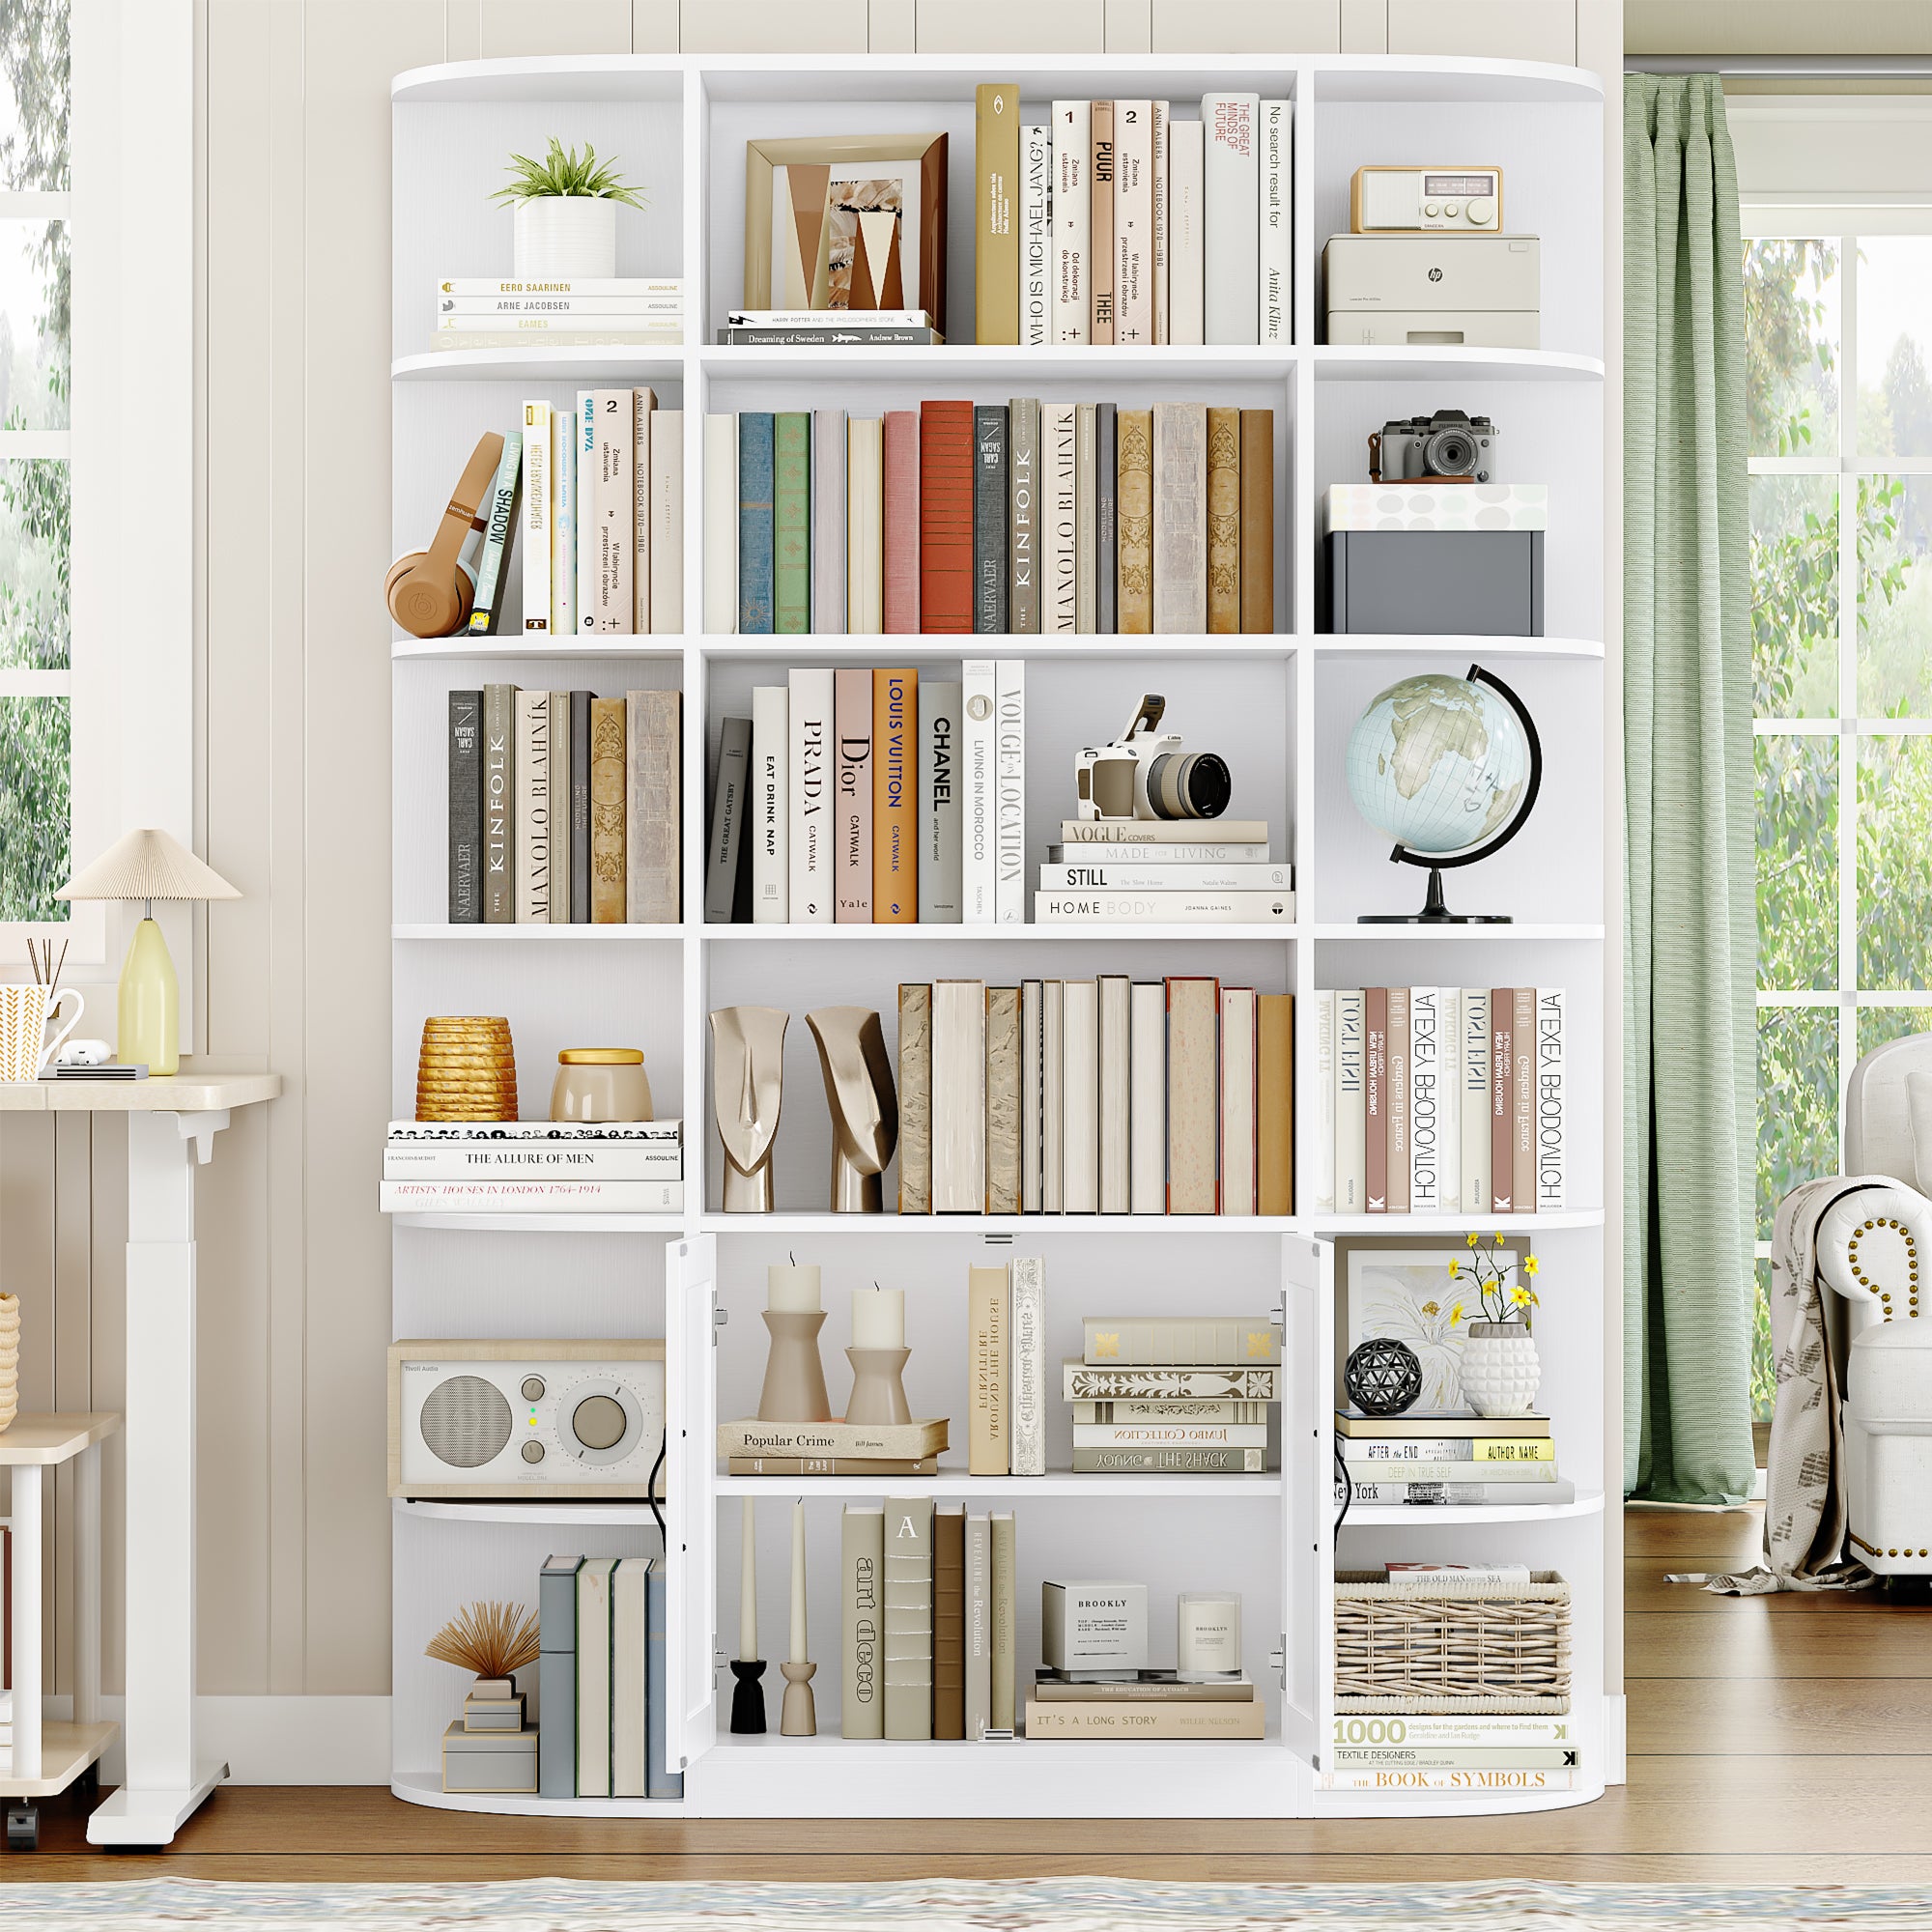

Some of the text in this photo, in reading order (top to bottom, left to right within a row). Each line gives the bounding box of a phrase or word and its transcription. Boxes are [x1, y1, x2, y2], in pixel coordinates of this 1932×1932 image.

[1065, 111, 1073, 123] 1
[1125, 111, 1137, 123] 2
[1215, 102, 1226, 142] FUTURE
[1227, 102, 1237, 150] MINDS OF
[1238, 103, 1250, 157] THE GREAT
[1096, 141, 1112, 182] PUUR
[1269, 106, 1281, 228] No search result for
[1029, 142, 1043, 345] WHO IS MICHAEL JANG?
[1061, 249, 1069, 303] do konstrukcji
[1070, 252, 1080, 300] Od dekoracji
[1428, 268, 1442, 282] hp
[500, 283, 523, 292] EERO
[526, 283, 571, 292] SAARINEN
[497, 301, 521, 310] ARNE
[524, 301, 570, 310] JACOBSEN
[1096, 291, 1112, 324] THEE
[1268, 268, 1281, 339] Anita Klinz
[519, 320, 549, 328] EAMES
[749, 333, 784, 344] Dreaming
[786, 333, 795, 342] of
[795, 333, 824, 342] Sweden
[607, 400, 617, 412] 2
[506, 441, 520, 469] LIVING
[980, 441, 1001, 453] SAGAN
[983, 454, 999, 464] CARL
[504, 470, 515, 480] IN
[490, 489, 513, 545] SHADOW
[1053, 412, 1074, 631] MANOLO BLAHNÍK
[984, 558, 997, 633] NAERVAER
[890, 679, 903, 729] LOUIS
[804, 720, 822, 816] PRADA
[933, 718, 951, 812] CHANEL
[974, 740, 983, 779] LIVING
[889, 736, 903, 808] VUITTON
[974, 781, 983, 794] IN
[489, 735, 504, 873] KINFOLK
[841, 734, 870, 867] Dior CATWALK
[720, 782, 735, 864] THE GREAT GATSBY
[974, 795, 983, 861] MOROCCO
[1000, 774, 1021, 882] LOCATION
[1072, 827, 1126, 841] VOGUE
[1105, 847, 1150, 859] MADE
[1174, 847, 1226, 859] LIVING
[1066, 868, 1107, 886] STILL
[840, 899, 867, 908] Yale
[1050, 901, 1100, 914] HOME
[1107, 901, 1156, 914] BODY
[466, 1153, 492, 1164] THE
[495, 1153, 543, 1164] ALLURE
[546, 1153, 563, 1164] OF
[566, 1153, 594, 1164] MEN
[744, 1434, 884, 1448] Popular Crime Bill James
[1368, 1445, 1391, 1459] AFTER
[1404, 1445, 1418, 1459] END
[1488, 1445, 1538, 1460] AUTHOR NAME
[1354, 1484, 1378, 1499] York
[896, 1516, 919, 1538] A
[856, 1557, 876, 1704] art deco
[973, 1600, 983, 1657] Revolution
[1037, 1715, 1065, 1725] IT'S
[1071, 1716, 1079, 1725] A
[1087, 1716, 1115, 1725] LONG
[1122, 1716, 1157, 1725] STORY
[1333, 1719, 1406, 1744] 1000
[1408, 1723, 1431, 1732] designs
[1454, 1723, 1478, 1732] gardens
[1338, 1750, 1416, 1759] TEXTILE DESIGNERS
[1376, 1772, 1430, 1787] BOOK
[1451, 1772, 1546, 1787] SYMBOLS
